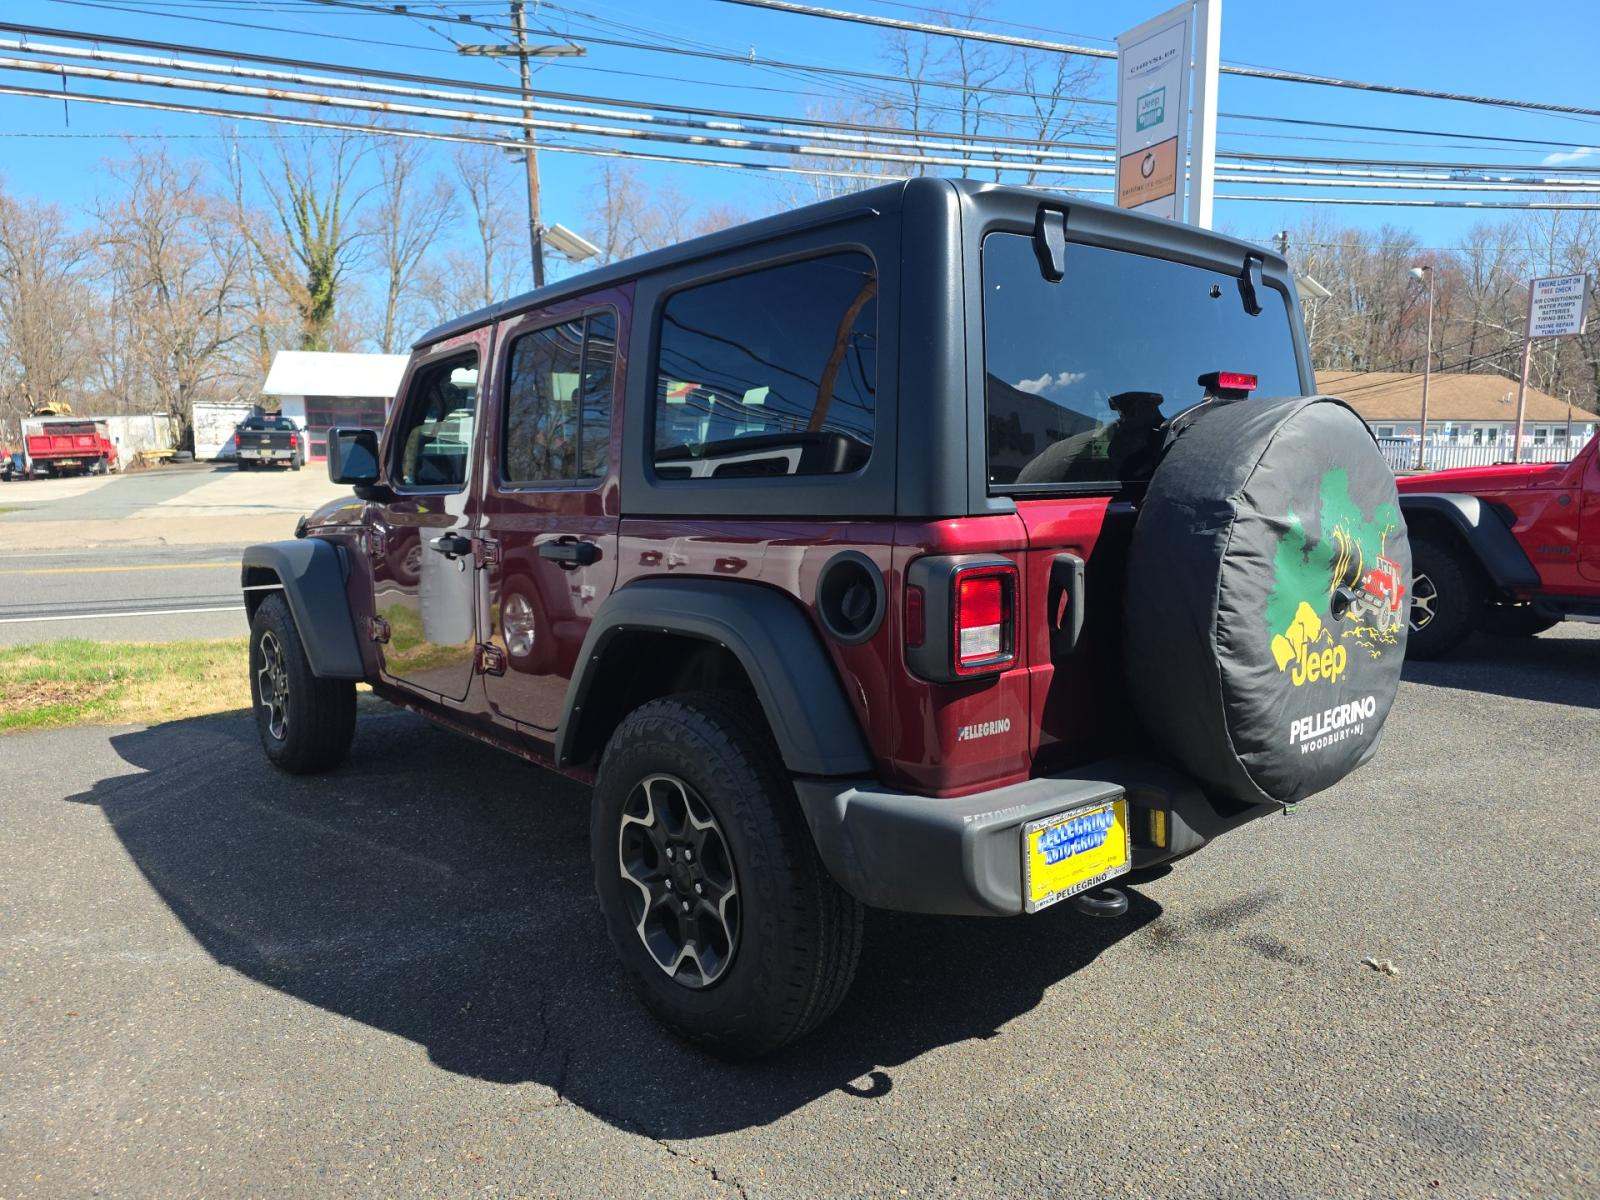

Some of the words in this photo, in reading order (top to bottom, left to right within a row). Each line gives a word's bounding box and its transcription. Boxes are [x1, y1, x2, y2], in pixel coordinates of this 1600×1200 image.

[1130, 48, 1175, 73] CHRYSLER
[1142, 97, 1160, 110] Jeep
[1539, 280, 1556, 288] ENGINE
[1544, 295, 1582, 303] CONDITIONING
[1292, 644, 1347, 687] Jeep
[958, 718, 1010, 741] PELLEGRINO
[1289, 695, 1376, 745] PELLEGRINO
[1038, 810, 1115, 854] PELLEGRINO
[1044, 845, 1073, 865] AUTO
[1073, 830, 1107, 855] GROUP
[1056, 873, 1107, 901] PELLEGRINO
